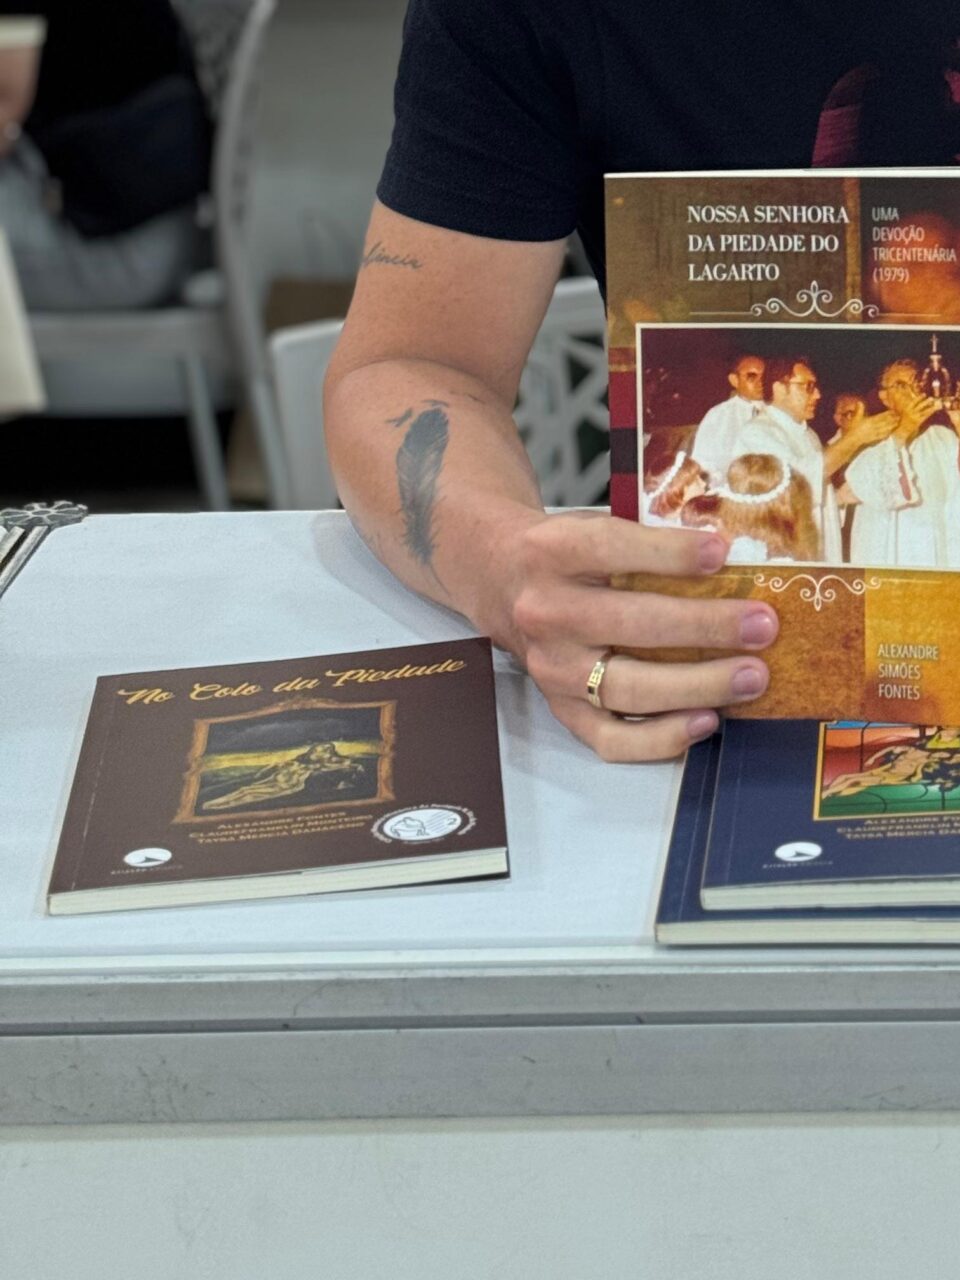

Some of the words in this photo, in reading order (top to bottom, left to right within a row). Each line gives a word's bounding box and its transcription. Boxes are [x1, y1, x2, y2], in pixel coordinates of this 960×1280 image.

[687, 205, 750, 223] NOSSA
[754, 205, 850, 224] SENHORA
[872, 207, 900, 222] UMA
[688, 234, 715, 252] DA
[720, 234, 806, 253] PIEDADE
[810, 234, 840, 253] DO
[872, 224, 925, 245] DEVOÇÃO
[872, 243, 957, 262] TRICENTENÁRIA
[688, 263, 780, 282] LAGARTO
[872, 267, 910, 284] (1979)
[877, 643, 939, 661] ALEXANDRE
[878, 662, 921, 680] SIMÕES
[117, 688, 176, 705] No
[189, 682, 262, 701] Colo
[272, 676, 320, 693] da
[325, 659, 467, 687] Piedade
[878, 683, 921, 701] FONTES
